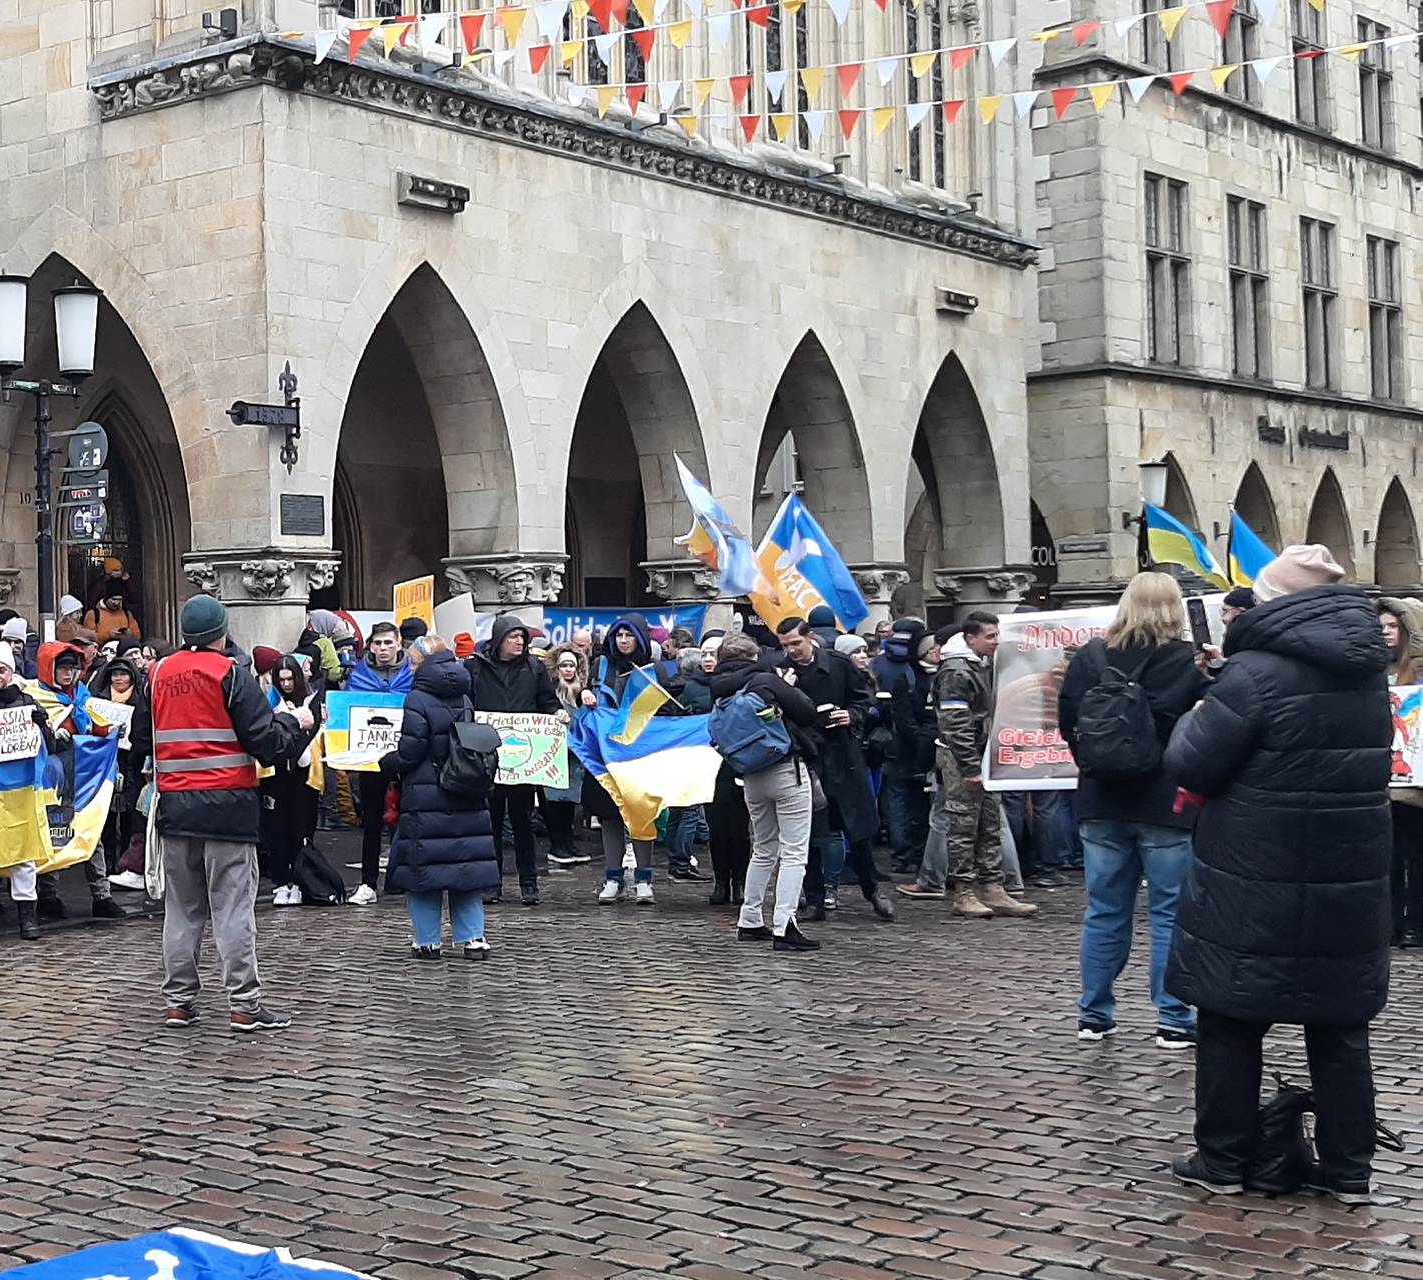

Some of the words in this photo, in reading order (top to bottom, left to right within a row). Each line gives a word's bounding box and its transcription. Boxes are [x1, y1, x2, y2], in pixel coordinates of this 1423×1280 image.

[20, 491, 31, 504] 10
[1018, 623, 1108, 652] Ander
[157, 669, 202, 696] peace
[487, 713, 529, 726] Frieden
[998, 747, 1074, 768] Ergebn
